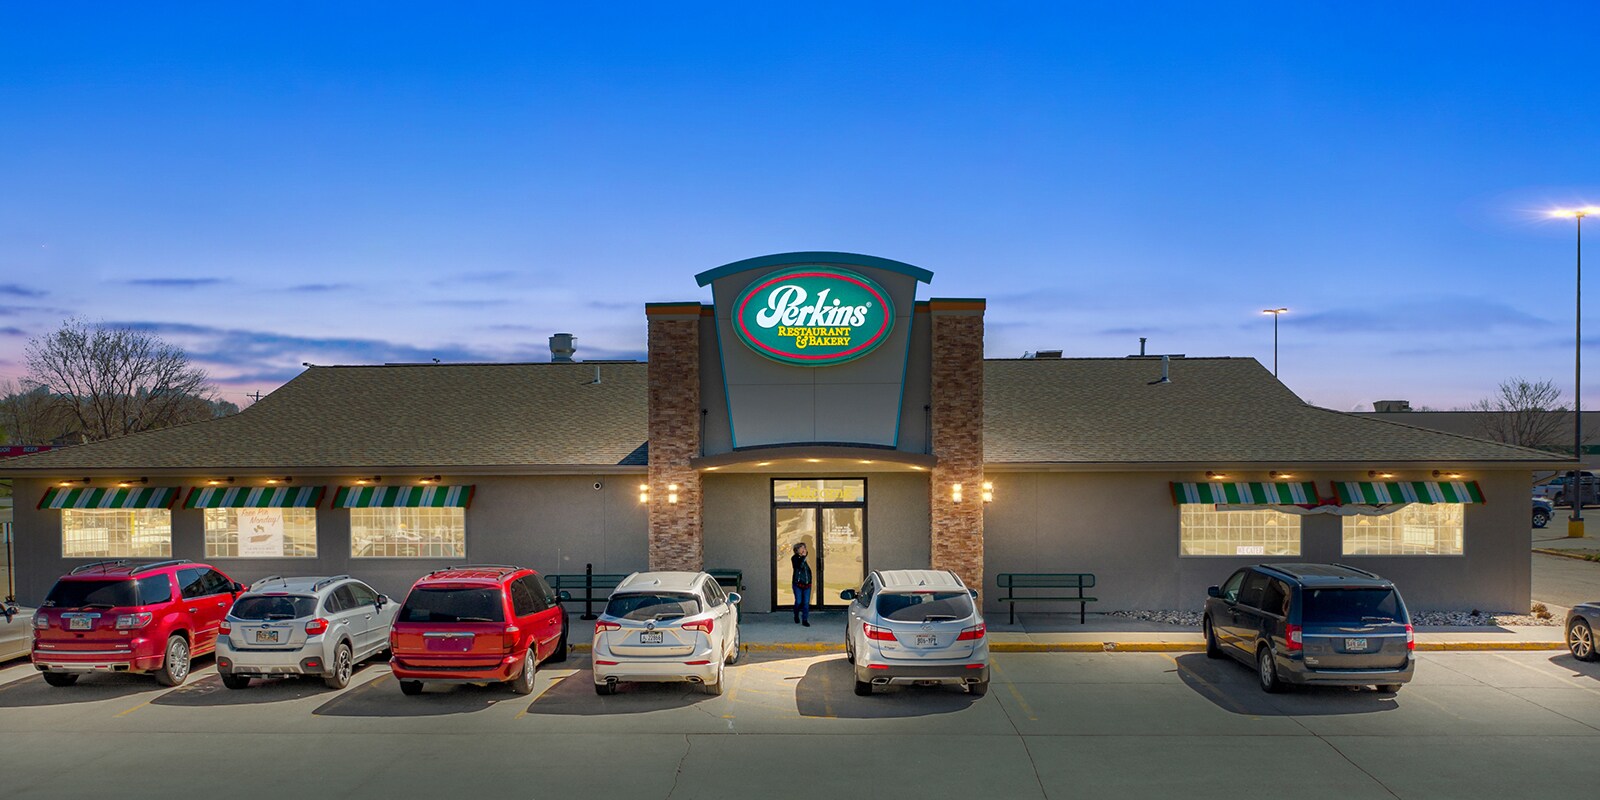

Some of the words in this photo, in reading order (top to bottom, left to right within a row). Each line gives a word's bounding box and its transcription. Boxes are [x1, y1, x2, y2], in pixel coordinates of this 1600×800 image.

[756, 285, 868, 328] Perkins
[778, 326, 851, 337] RESTAURANT
[809, 337, 851, 346] BAKERY
